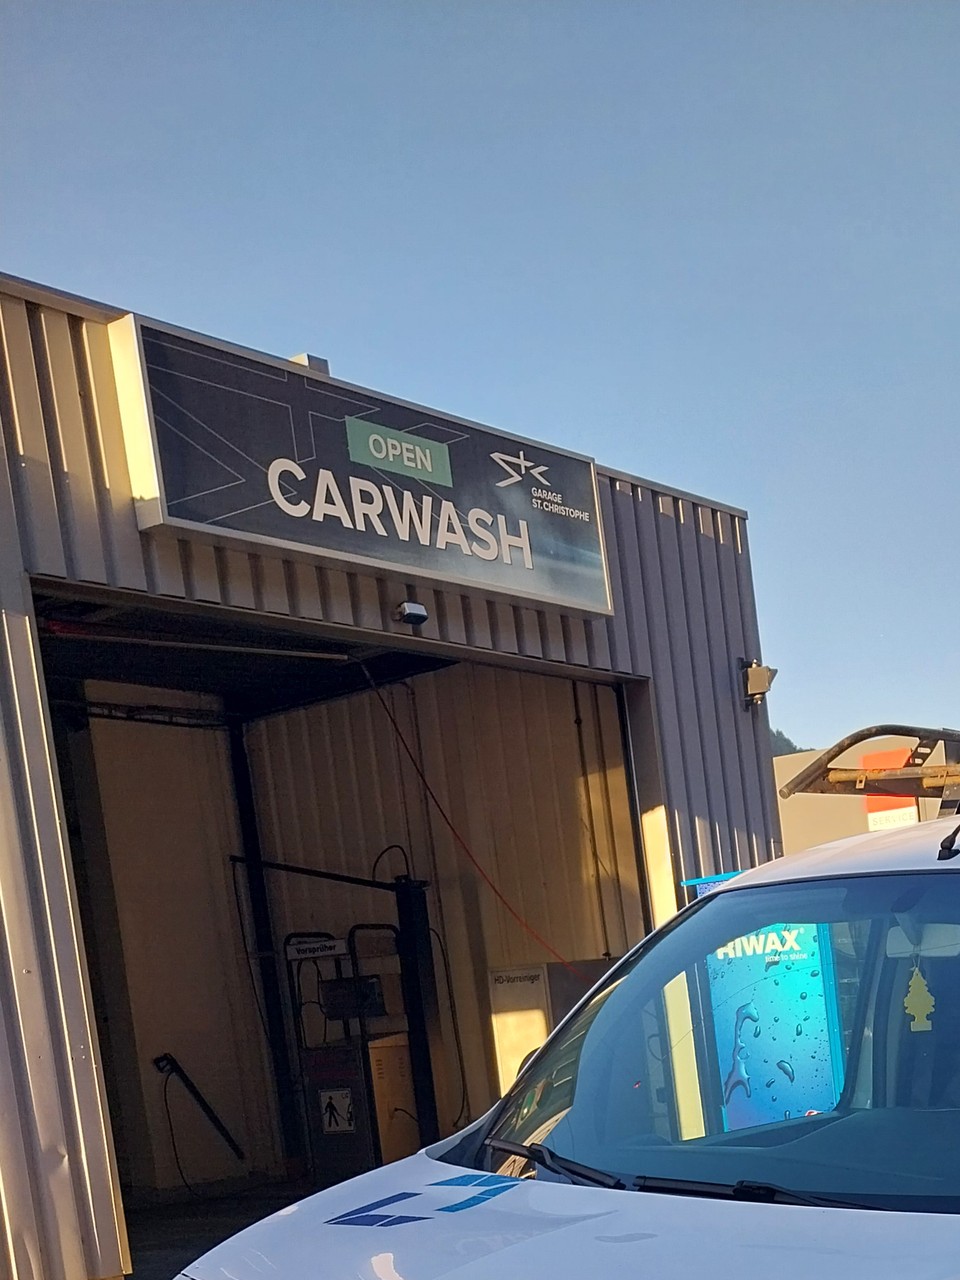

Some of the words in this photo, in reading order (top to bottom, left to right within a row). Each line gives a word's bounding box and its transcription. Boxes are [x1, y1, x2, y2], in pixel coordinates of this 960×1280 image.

[368, 433, 433, 472] OPEN
[531, 487, 563, 504] GARAGE
[267, 457, 534, 570] CARWASH
[872, 811, 915, 826] SERVICE
[296, 944, 337, 955] Vorsprüher
